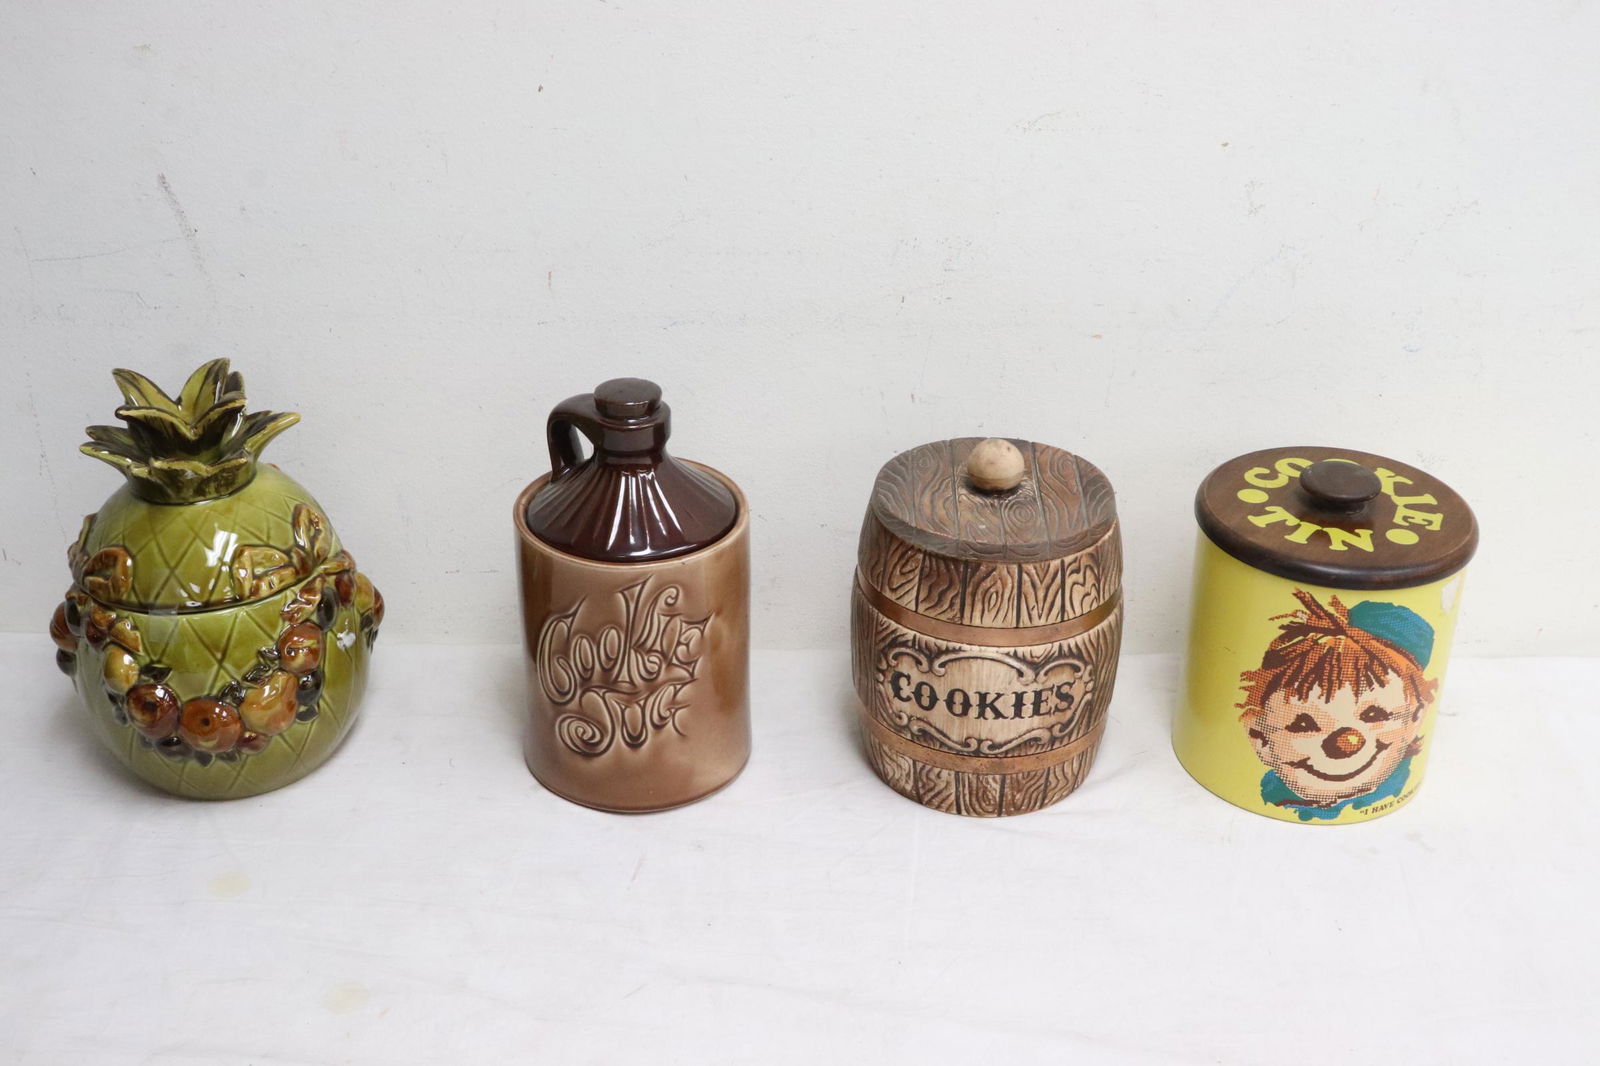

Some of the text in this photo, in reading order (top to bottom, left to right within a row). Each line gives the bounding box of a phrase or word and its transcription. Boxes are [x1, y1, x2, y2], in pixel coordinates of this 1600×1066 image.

[1244, 457, 1444, 532] COKIE
[1247, 505, 1374, 552] TIN
[556, 677, 699, 758] JUG
[890, 670, 1075, 720] COOKIES
[1371, 800, 1395, 814] HAVE
